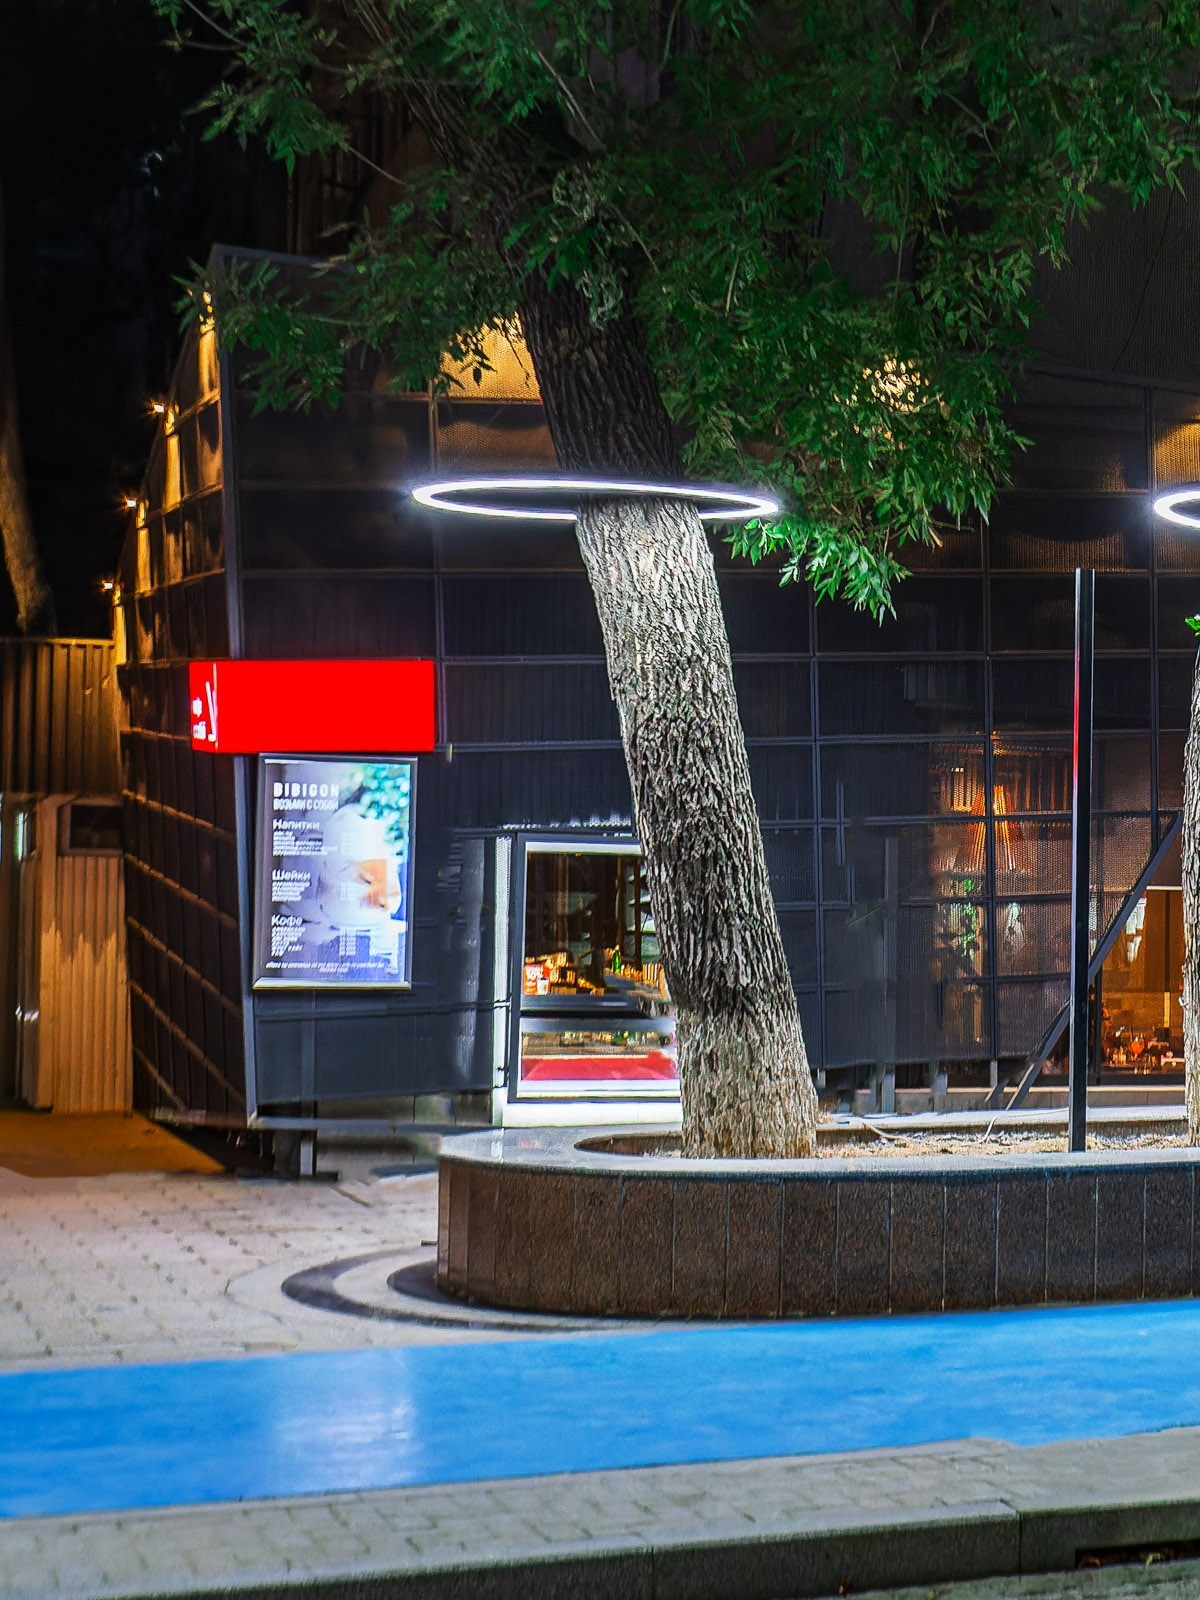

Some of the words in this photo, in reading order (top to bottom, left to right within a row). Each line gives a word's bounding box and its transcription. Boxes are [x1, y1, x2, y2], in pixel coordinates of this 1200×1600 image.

[273, 782, 340, 798] BIBIGON
[272, 818, 320, 831] Напитки
[271, 869, 311, 881] Шейки
[271, 914, 304, 927] Кофе
